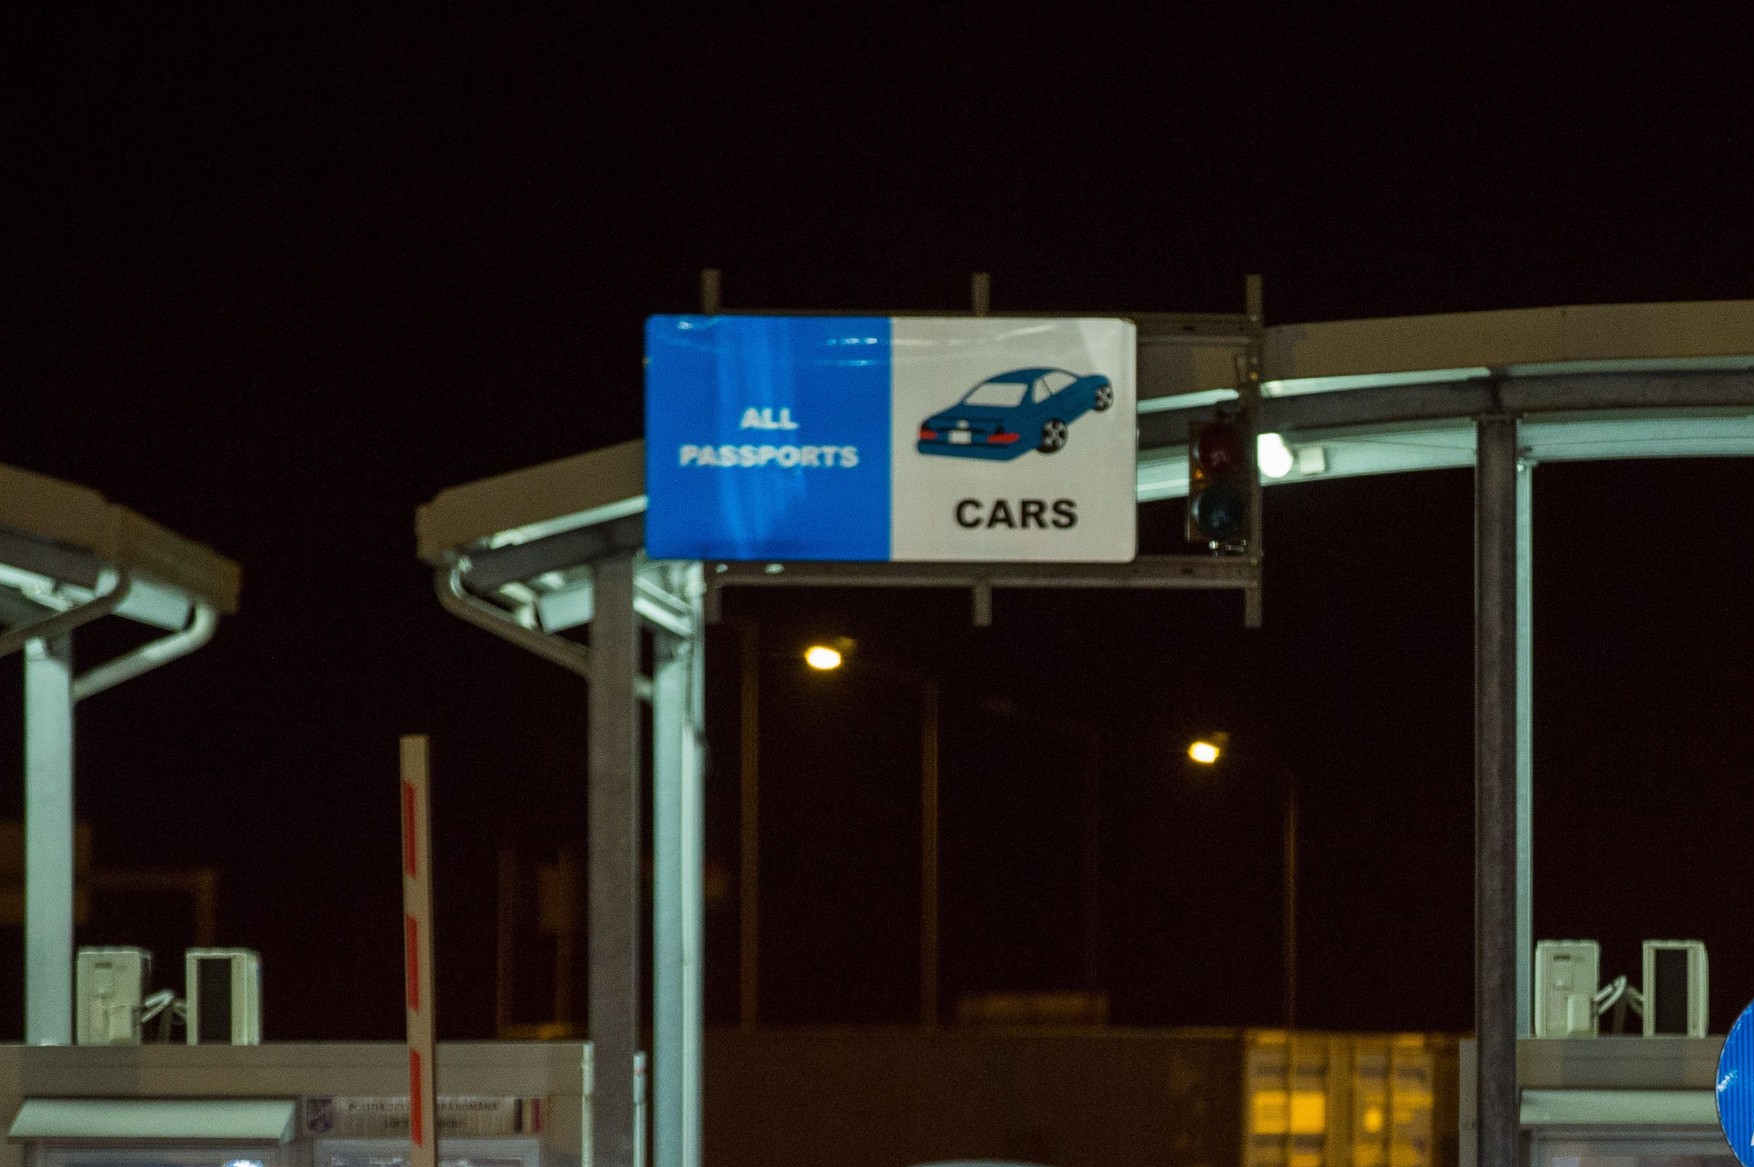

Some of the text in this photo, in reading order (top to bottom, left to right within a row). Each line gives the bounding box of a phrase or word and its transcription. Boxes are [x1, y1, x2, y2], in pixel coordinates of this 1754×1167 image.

[741, 407, 799, 430] ALL
[679, 445, 860, 468] PASSPORTS
[955, 498, 1079, 530] CARS
